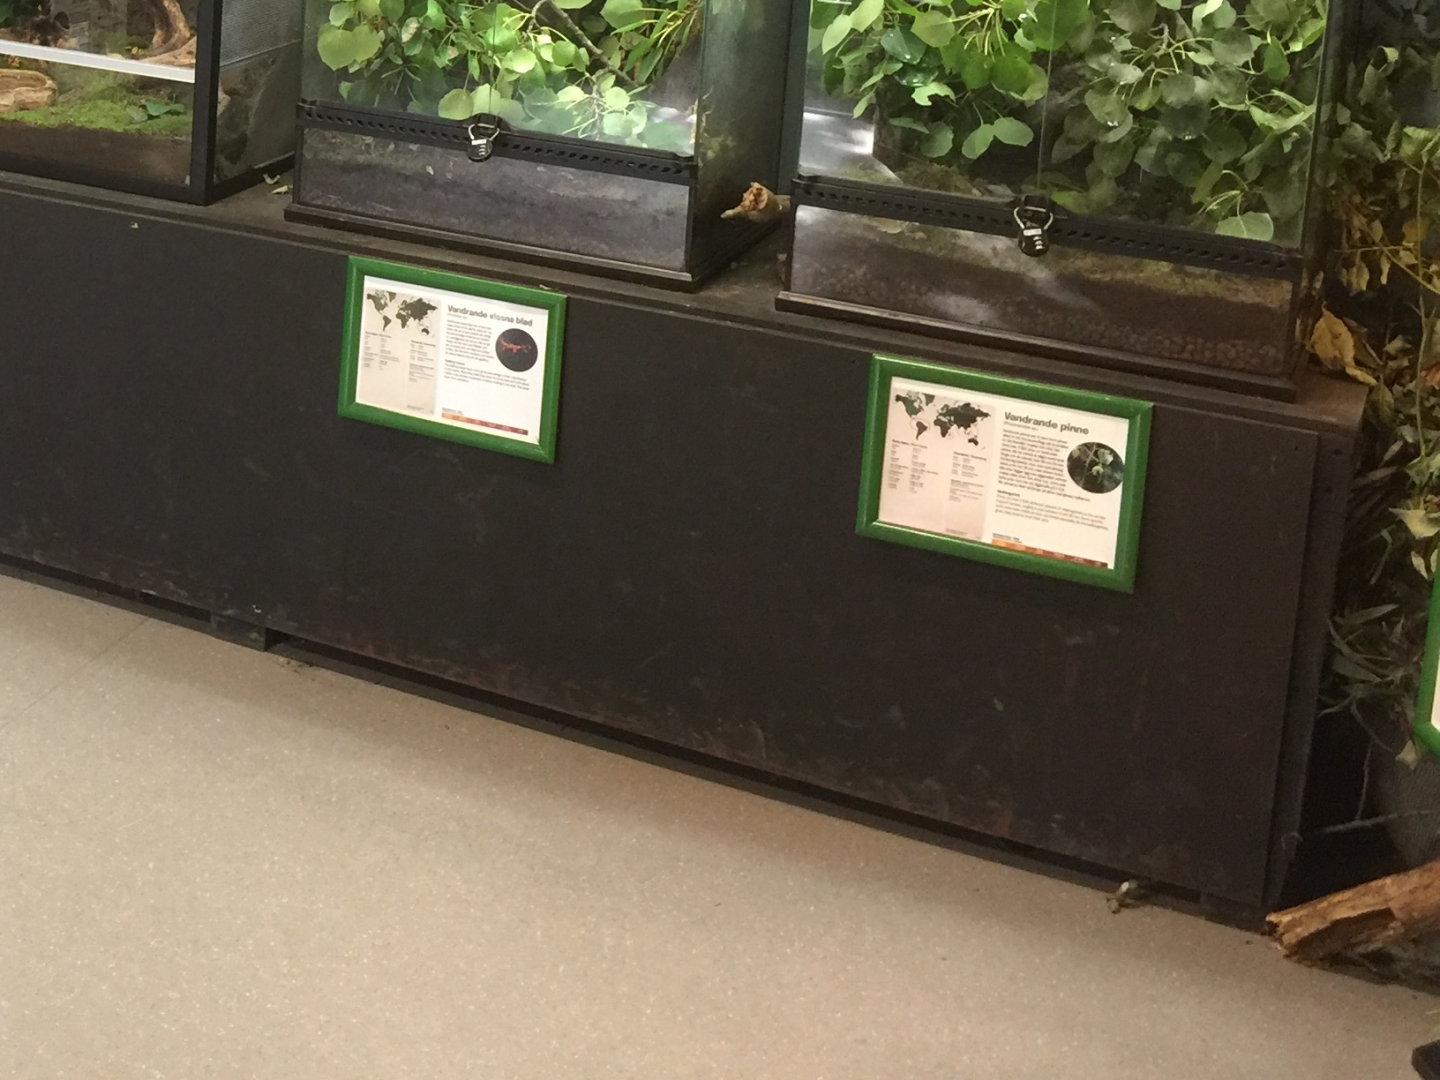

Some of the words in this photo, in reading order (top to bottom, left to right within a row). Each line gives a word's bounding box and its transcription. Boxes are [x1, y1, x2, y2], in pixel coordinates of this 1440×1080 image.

[447, 304, 488, 319] Vandrande
[515, 316, 534, 327] blad
[1004, 411, 1058, 430] Vandrande
[1059, 422, 1090, 436] pinne
